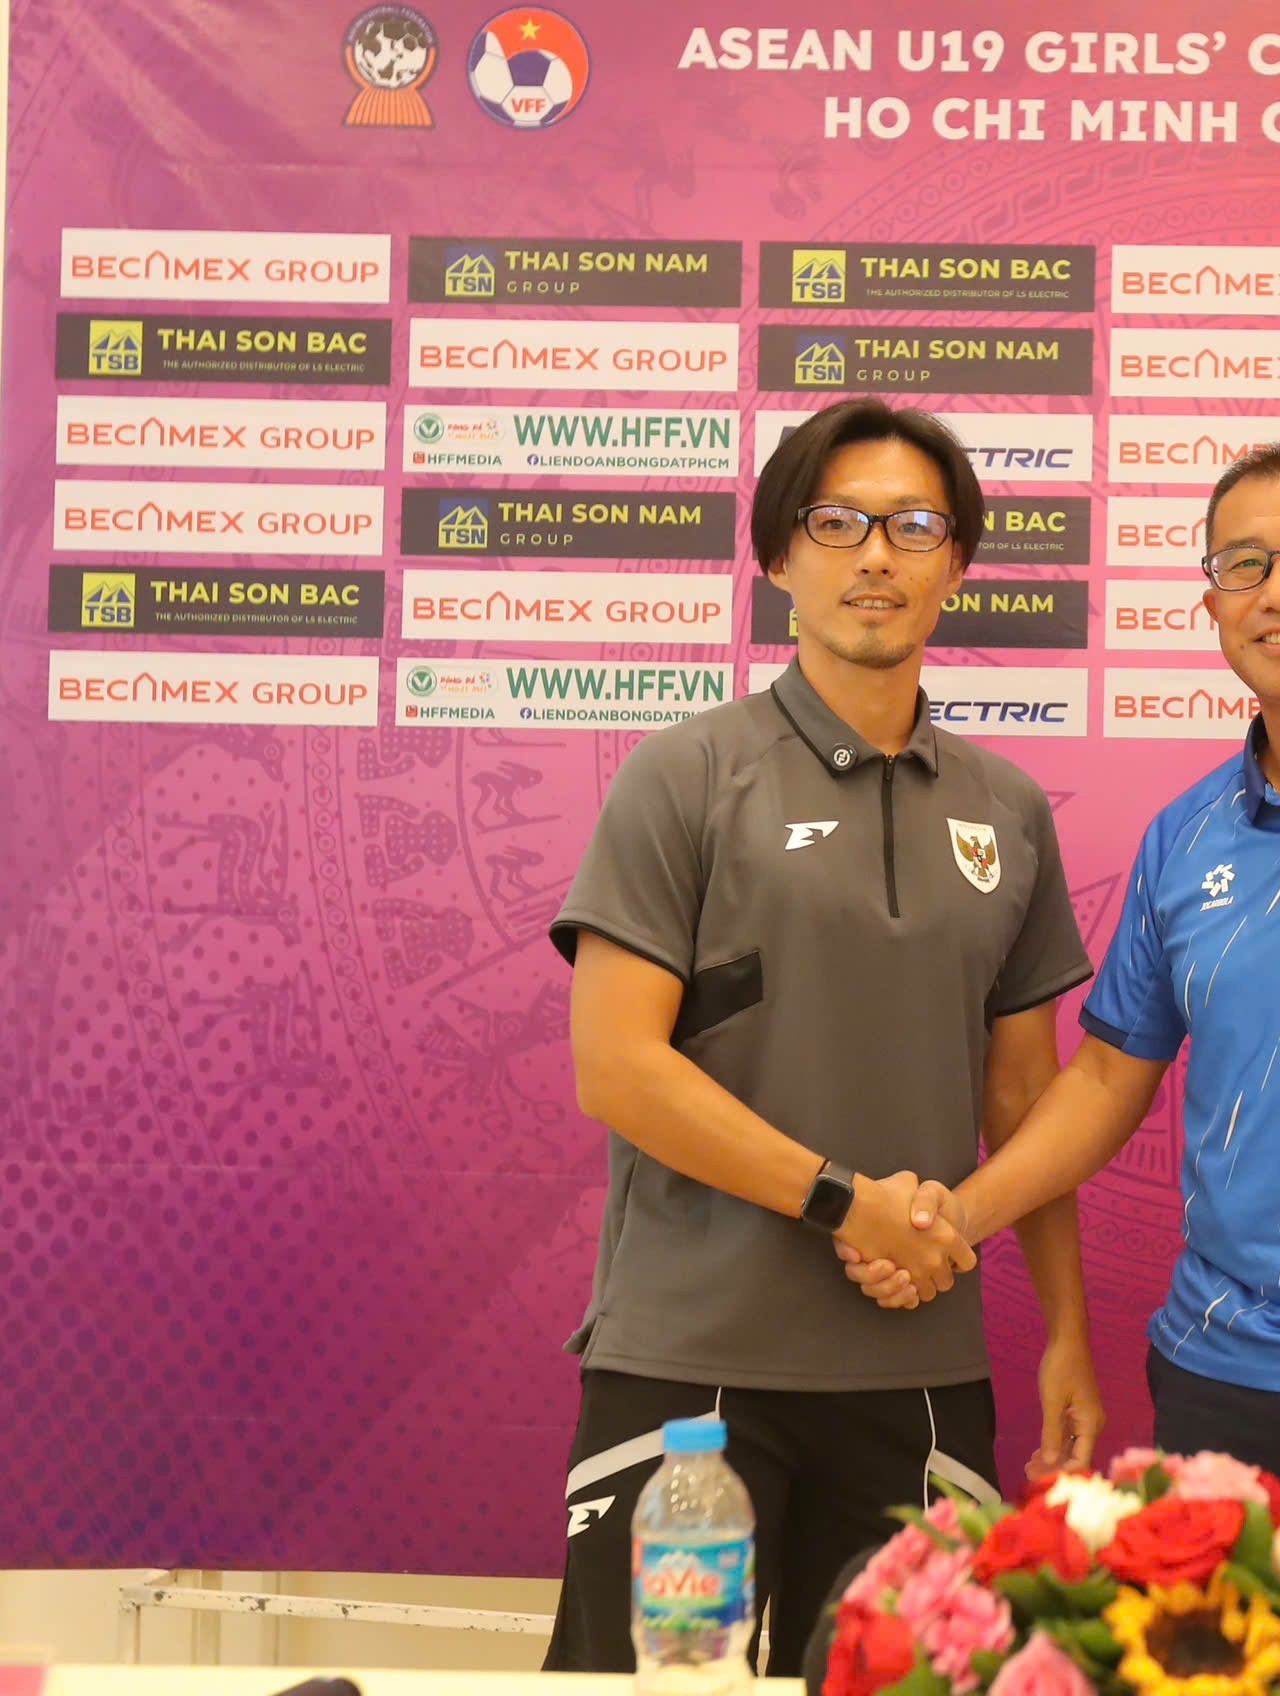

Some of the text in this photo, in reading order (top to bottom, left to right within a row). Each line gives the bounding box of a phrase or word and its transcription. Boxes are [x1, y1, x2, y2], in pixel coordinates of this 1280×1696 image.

[679, 28, 871, 70] ASEAN
[899, 31, 1004, 71] U19
[511, 97, 546, 114] VFF
[825, 97, 910, 138] HO
[933, 98, 1044, 140] CHI
[1072, 100, 1237, 142] MINH
[72, 250, 379, 283] BECAMEX GROUP
[505, 251, 707, 272] THAI SON NAM
[861, 258, 1070, 279] THAI SON BAC
[448, 277, 492, 292] TSN
[507, 281, 579, 293] GROUP
[795, 282, 842, 299] TSB
[866, 288, 1069, 298] THE AUTHORIZED DISTRIBUTOR OF LS ELECTRIC
[158, 329, 366, 353] THAI SON BAC
[855, 340, 1058, 359] THAI SON NAM
[92, 353, 138, 370] TSB
[420, 340, 726, 371] BECAMEX GROUP
[163, 360, 365, 372] THE AUTHORIZED DISTRIBUTOR OF LS ELECTRIC
[798, 364, 842, 381] TSN
[857, 370, 930, 381] GROUP
[67, 417, 374, 450] BECAMEX GROUP
[514, 415, 730, 448] WWW.HFF.VN
[428, 454, 502, 464] HFFMEDIA
[541, 456, 728, 468] LIENDOANBONGDATPHCM
[65, 502, 372, 535] BECAMEX GROUP
[498, 503, 700, 524] THAI SON NAM
[1005, 511, 1067, 532] BAC
[442, 529, 485, 544] TSN
[500, 533, 572, 545] GROUP
[998, 542, 1009, 550] OF
[151, 581, 359, 605] THAI SON BAC
[413, 591, 720, 623] BECAMEX GROUP
[942, 593, 1054, 613] ON NAM
[85, 606, 131, 622] TSB
[155, 612, 358, 624] THE AUTHORIZED DISTRIBUTOR OF LS ELECTRIC
[60, 672, 367, 705] BECAMEX GROUP
[507, 668, 724, 702] WWW.HFF.VN
[421, 707, 495, 719] HFFMEDIA
[929, 701, 1068, 723] ECTRIC
[1114, 689, 1262, 719] BECAME
[533, 709, 697, 722] LIENDOANBONGDATP
